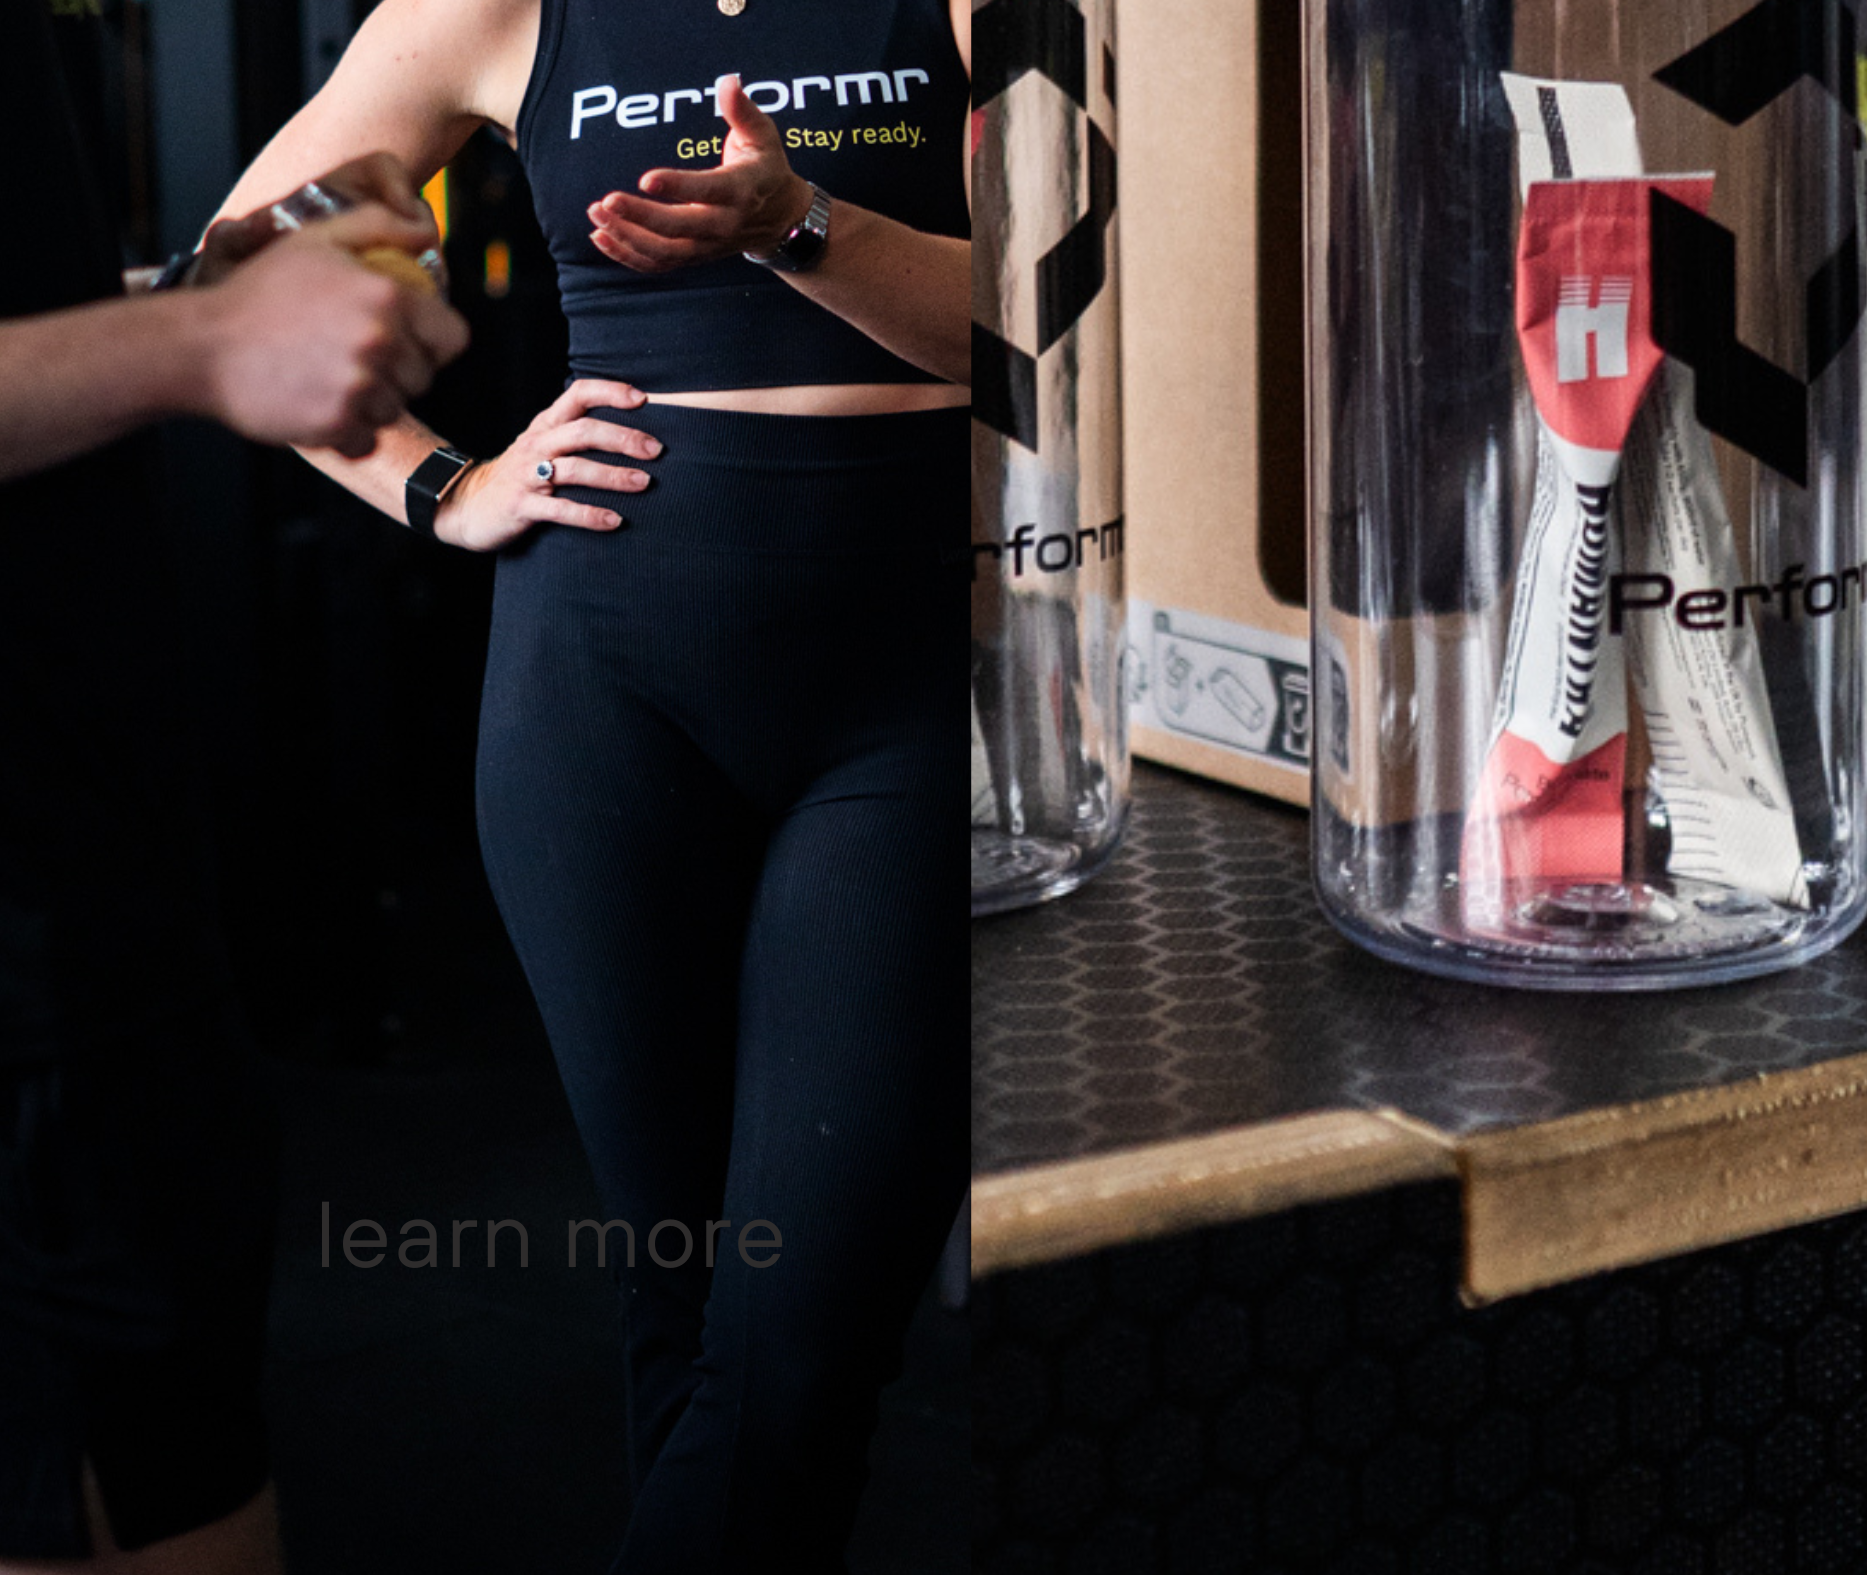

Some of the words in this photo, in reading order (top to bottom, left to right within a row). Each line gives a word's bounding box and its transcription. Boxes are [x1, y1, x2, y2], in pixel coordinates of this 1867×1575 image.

[676, 134, 722, 159] Get
[786, 126, 843, 151] Stay
[852, 121, 926, 148] ready.
[1555, 274, 1633, 383] H
